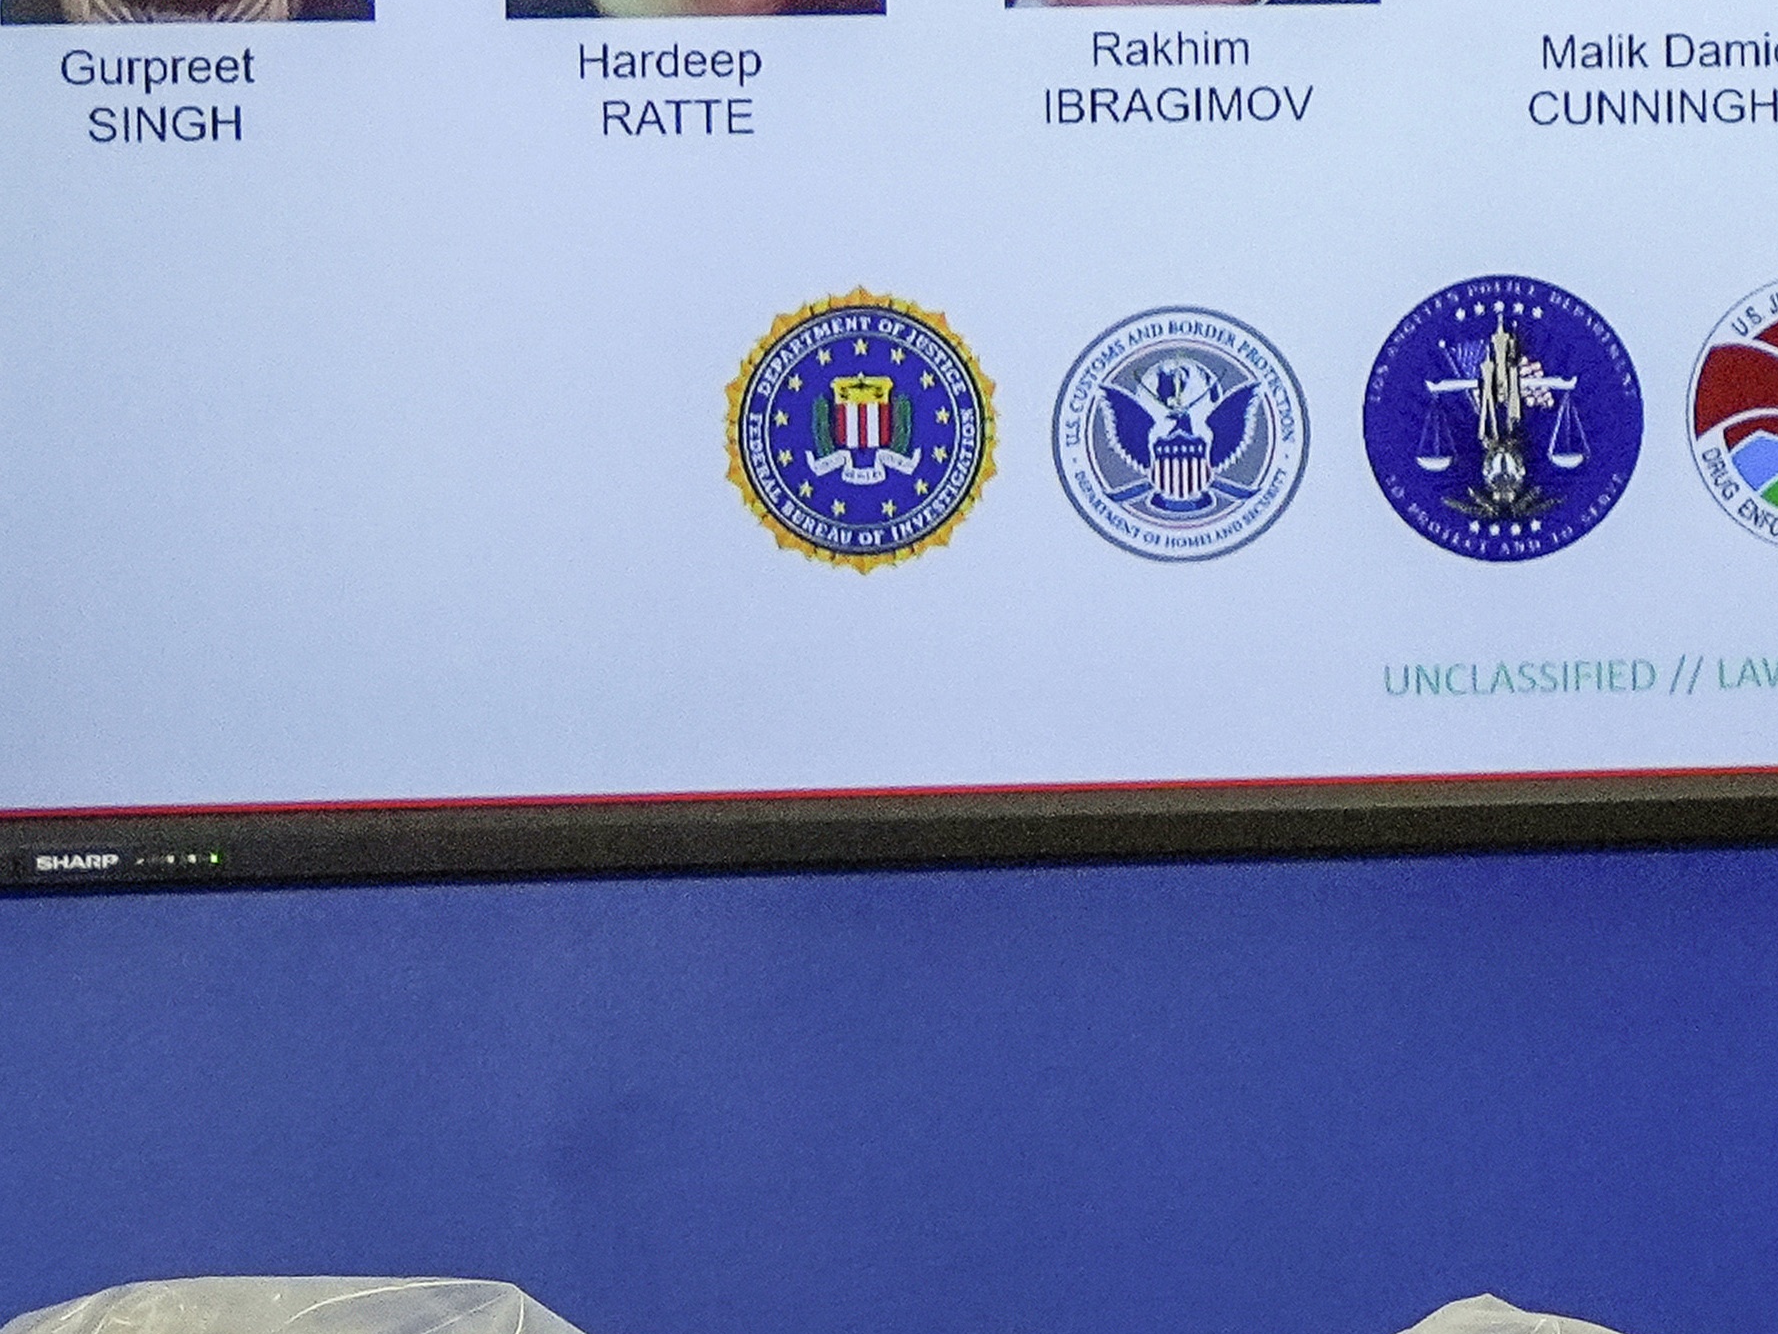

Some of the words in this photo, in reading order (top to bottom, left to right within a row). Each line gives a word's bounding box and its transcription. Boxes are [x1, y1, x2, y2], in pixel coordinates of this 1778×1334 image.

[60, 47, 256, 92] Gurpreet
[578, 42, 763, 84] Hardeep
[1092, 30, 1250, 68] Rakhim
[1541, 33, 1650, 71] Malik
[88, 104, 243, 144] SINGH
[602, 97, 755, 137] RATTE
[1044, 84, 1314, 125] IBRAGIMOV
[757, 316, 872, 397] DEPARTMENT
[878, 317, 905, 336] OF
[906, 329, 967, 395] JUSTICE
[1127, 322, 1164, 346] AND
[1168, 320, 1237, 348] BORDER
[1236, 339, 1296, 443] PROTECTION
[748, 412, 786, 503] FEDERAL
[857, 530, 885, 545] OF
[890, 407, 976, 541] INVESTIGATION
[1702, 447, 1740, 500] DRUG
[1384, 661, 1659, 696] UNCLASSIFIED
[36, 853, 120, 872] SHARP
